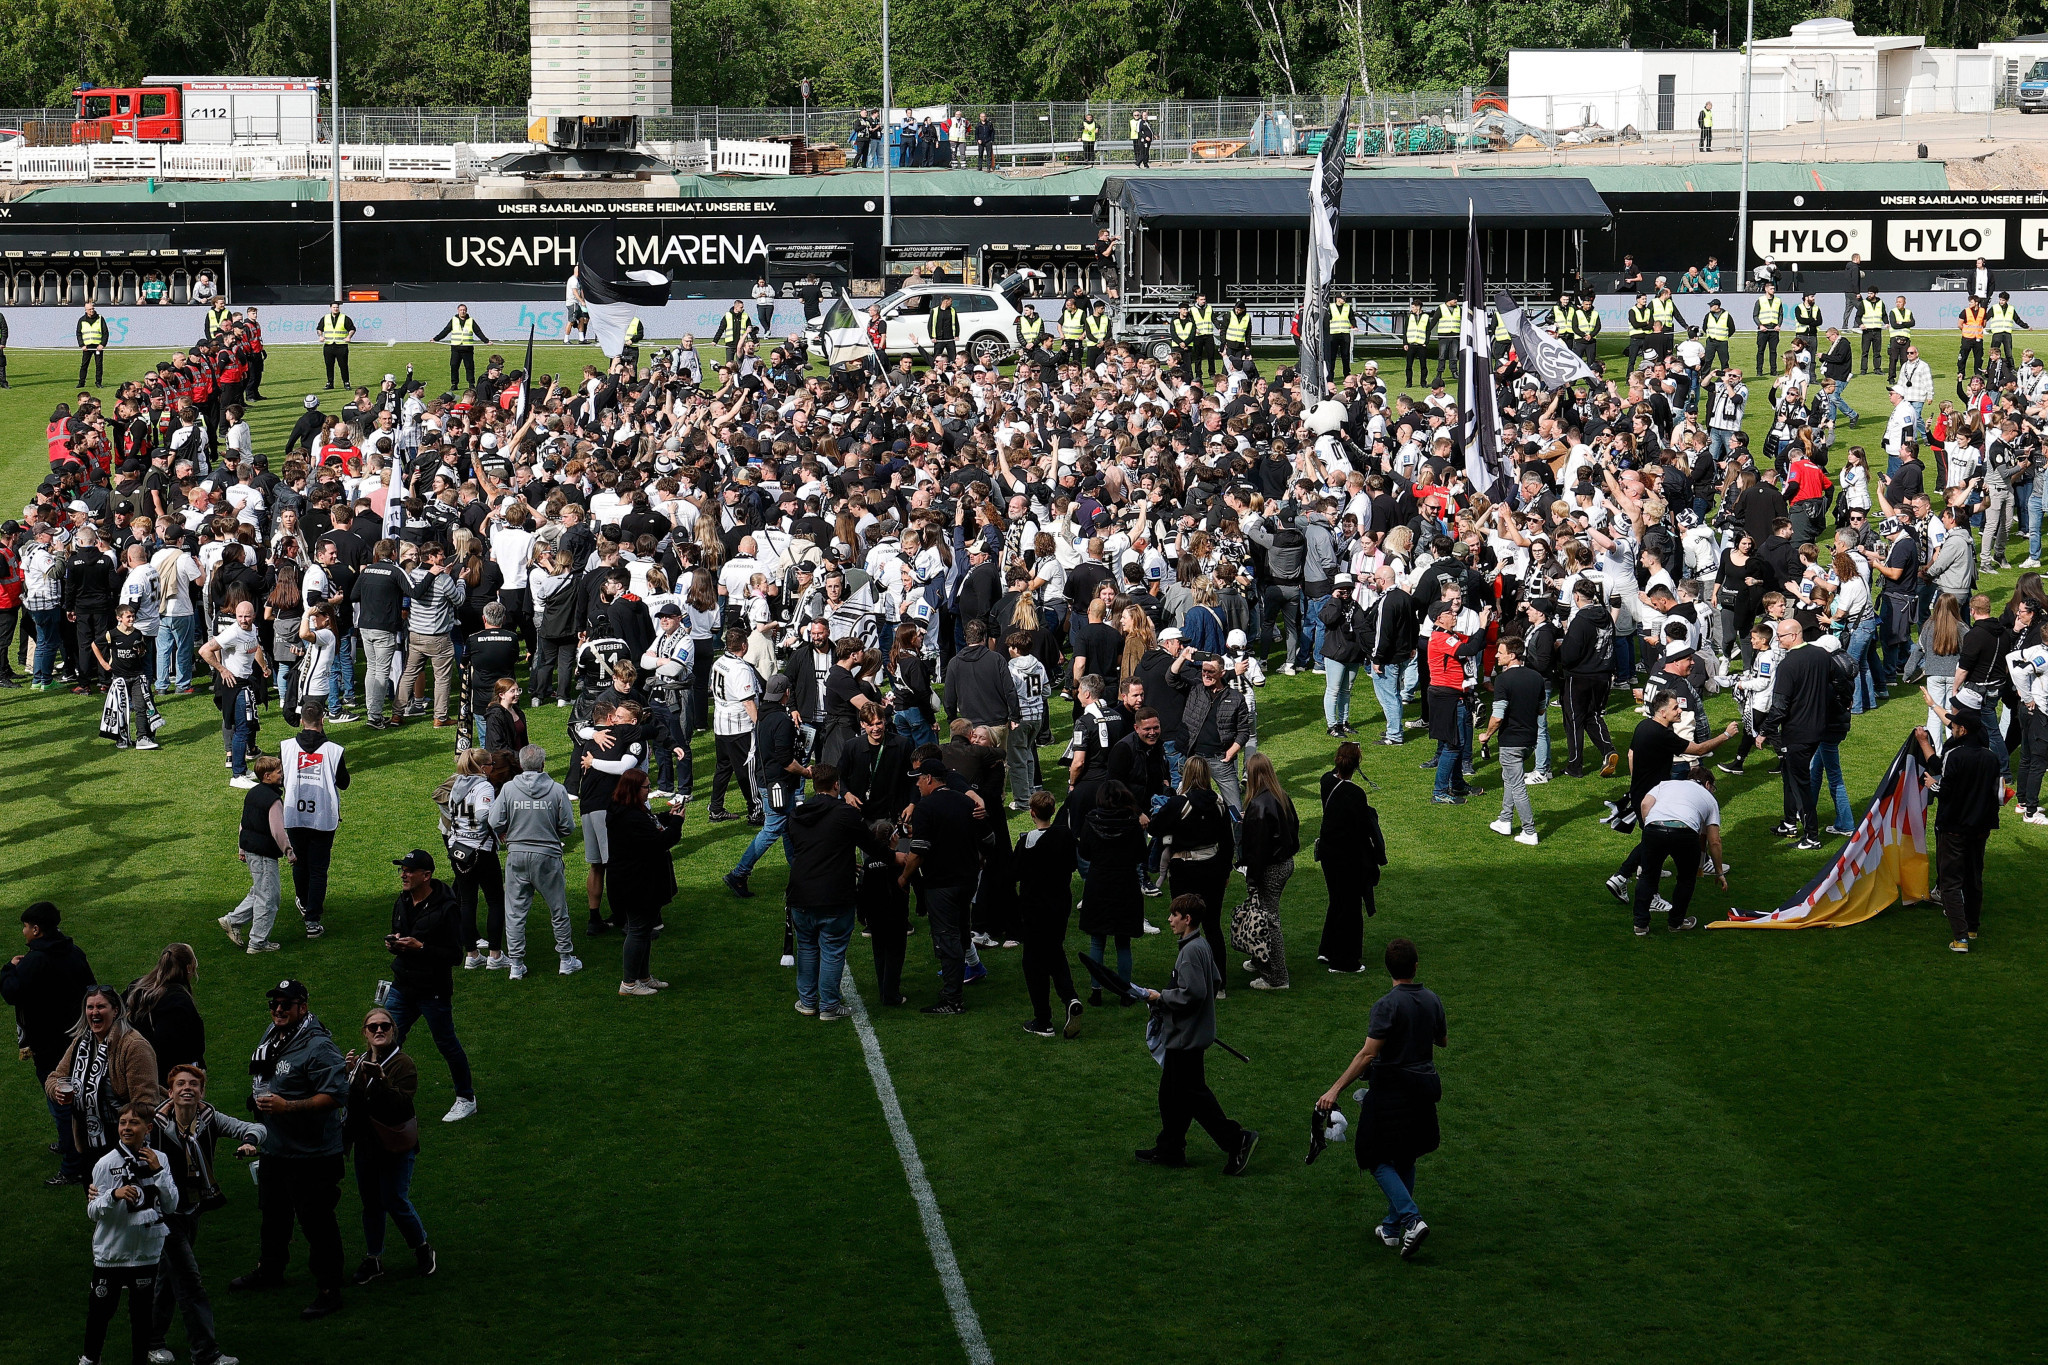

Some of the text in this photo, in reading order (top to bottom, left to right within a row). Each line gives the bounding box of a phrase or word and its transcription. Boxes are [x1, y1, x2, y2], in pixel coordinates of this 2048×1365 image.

[202, 108, 227, 118] 112
[1880, 195, 1917, 205] UNSER
[1919, 195, 1979, 205] SAARLAND.
[1981, 195, 2023, 204] UNSERE
[498, 202, 777, 213] UNSER SAARLAND. UNSERE HEIMAT. UNSERE ELV.
[785, 251, 833, 259] DECKERT
[518, 304, 565, 329] hcs
[477, 635, 513, 643] ELVERSBERG
[296, 799, 316, 813] 03
[513, 800, 552, 810] DIE ELV.
